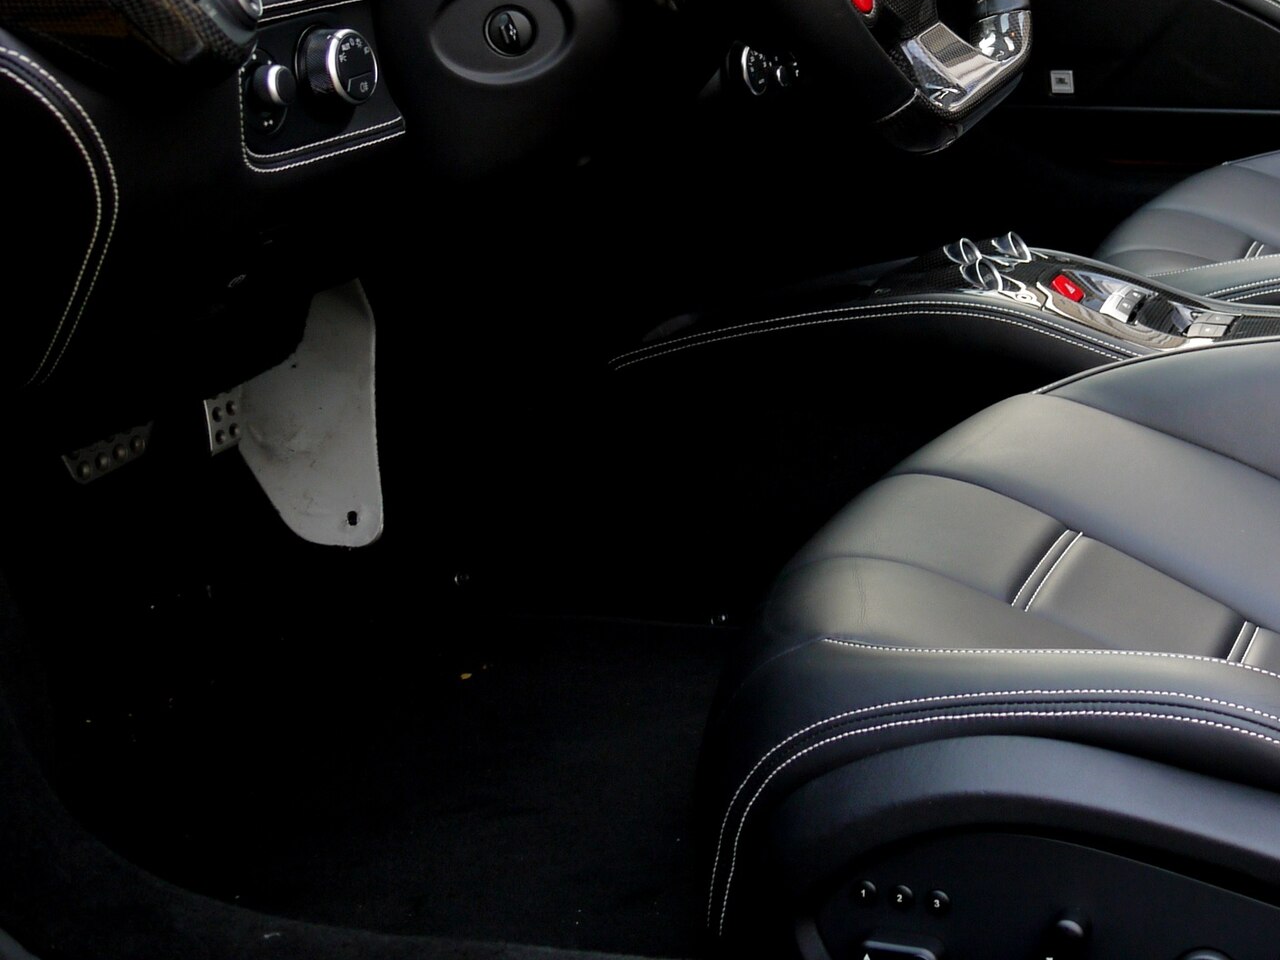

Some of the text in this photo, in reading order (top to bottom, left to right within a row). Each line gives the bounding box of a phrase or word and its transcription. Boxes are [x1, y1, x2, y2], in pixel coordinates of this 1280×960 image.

[860, 888, 866, 898] 1
[896, 894, 903, 903] 2
[933, 899, 941, 909] 3
